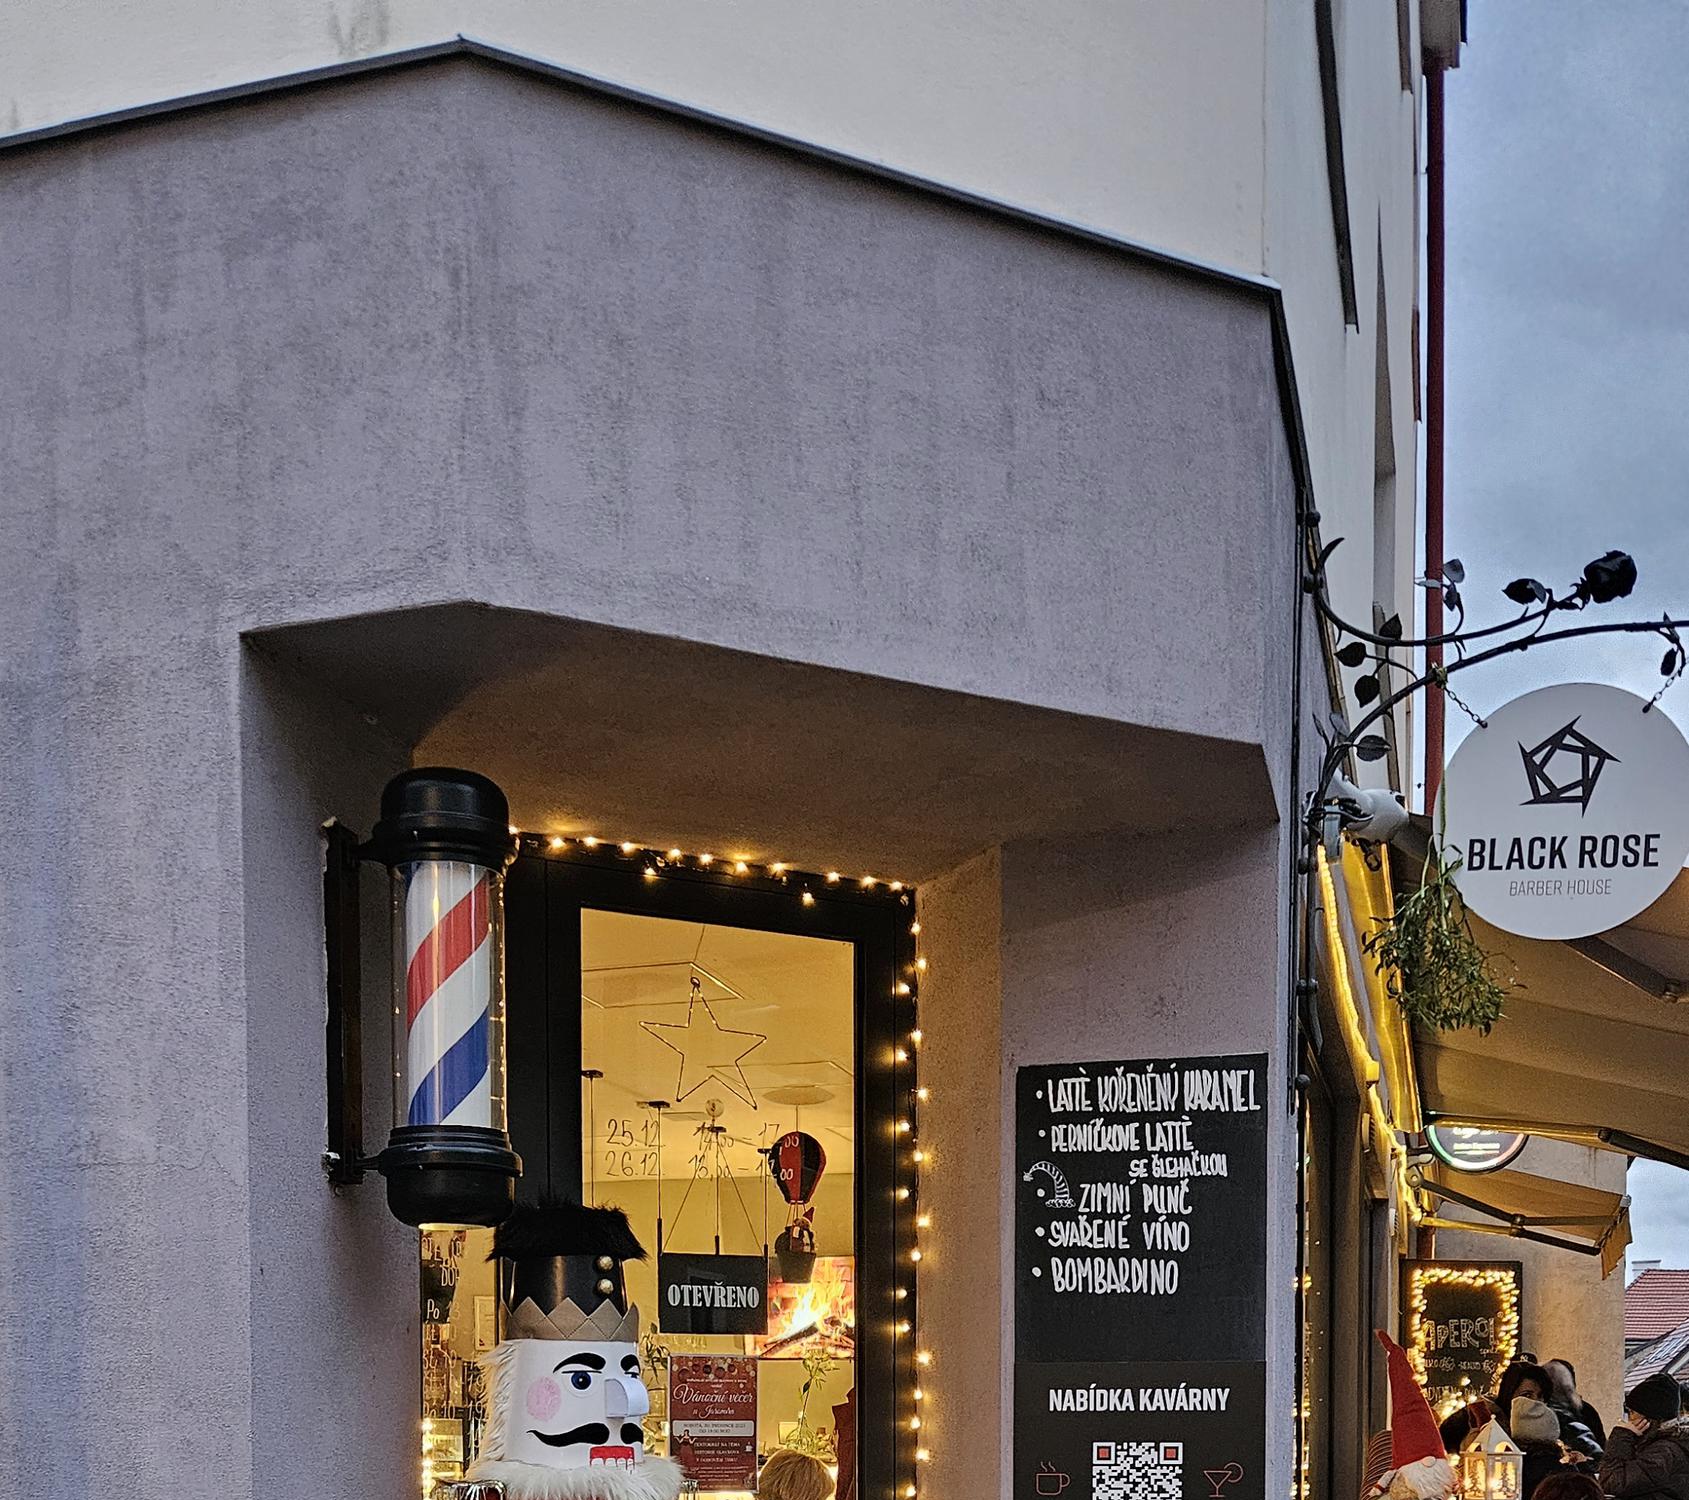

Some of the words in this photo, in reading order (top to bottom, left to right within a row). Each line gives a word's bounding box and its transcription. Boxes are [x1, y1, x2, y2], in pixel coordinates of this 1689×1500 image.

[1467, 835, 1568, 871] BLACK
[1578, 833, 1660, 869] ROSE
[1509, 879, 1562, 896] BARBER
[1567, 878, 1612, 895] HOUSE
[1183, 1069, 1260, 1112] KARAMEL
[1128, 1159, 1148, 1177] SE
[1078, 1178, 1137, 1213] ZIMNÍ
[1142, 1179, 1193, 1214] PUNČ
[1048, 1214, 1131, 1249] SVAŘENÉ
[1142, 1215, 1190, 1252] VÍNO
[1050, 1257, 1179, 1295] BOMBARDINO
[667, 1280, 760, 1309] OTEVŘENO
[673, 1383, 728, 1404] Vánoční
[1049, 1383, 1135, 1412] NABÍDKA
[1139, 1382, 1230, 1411] KAVÁRNY
